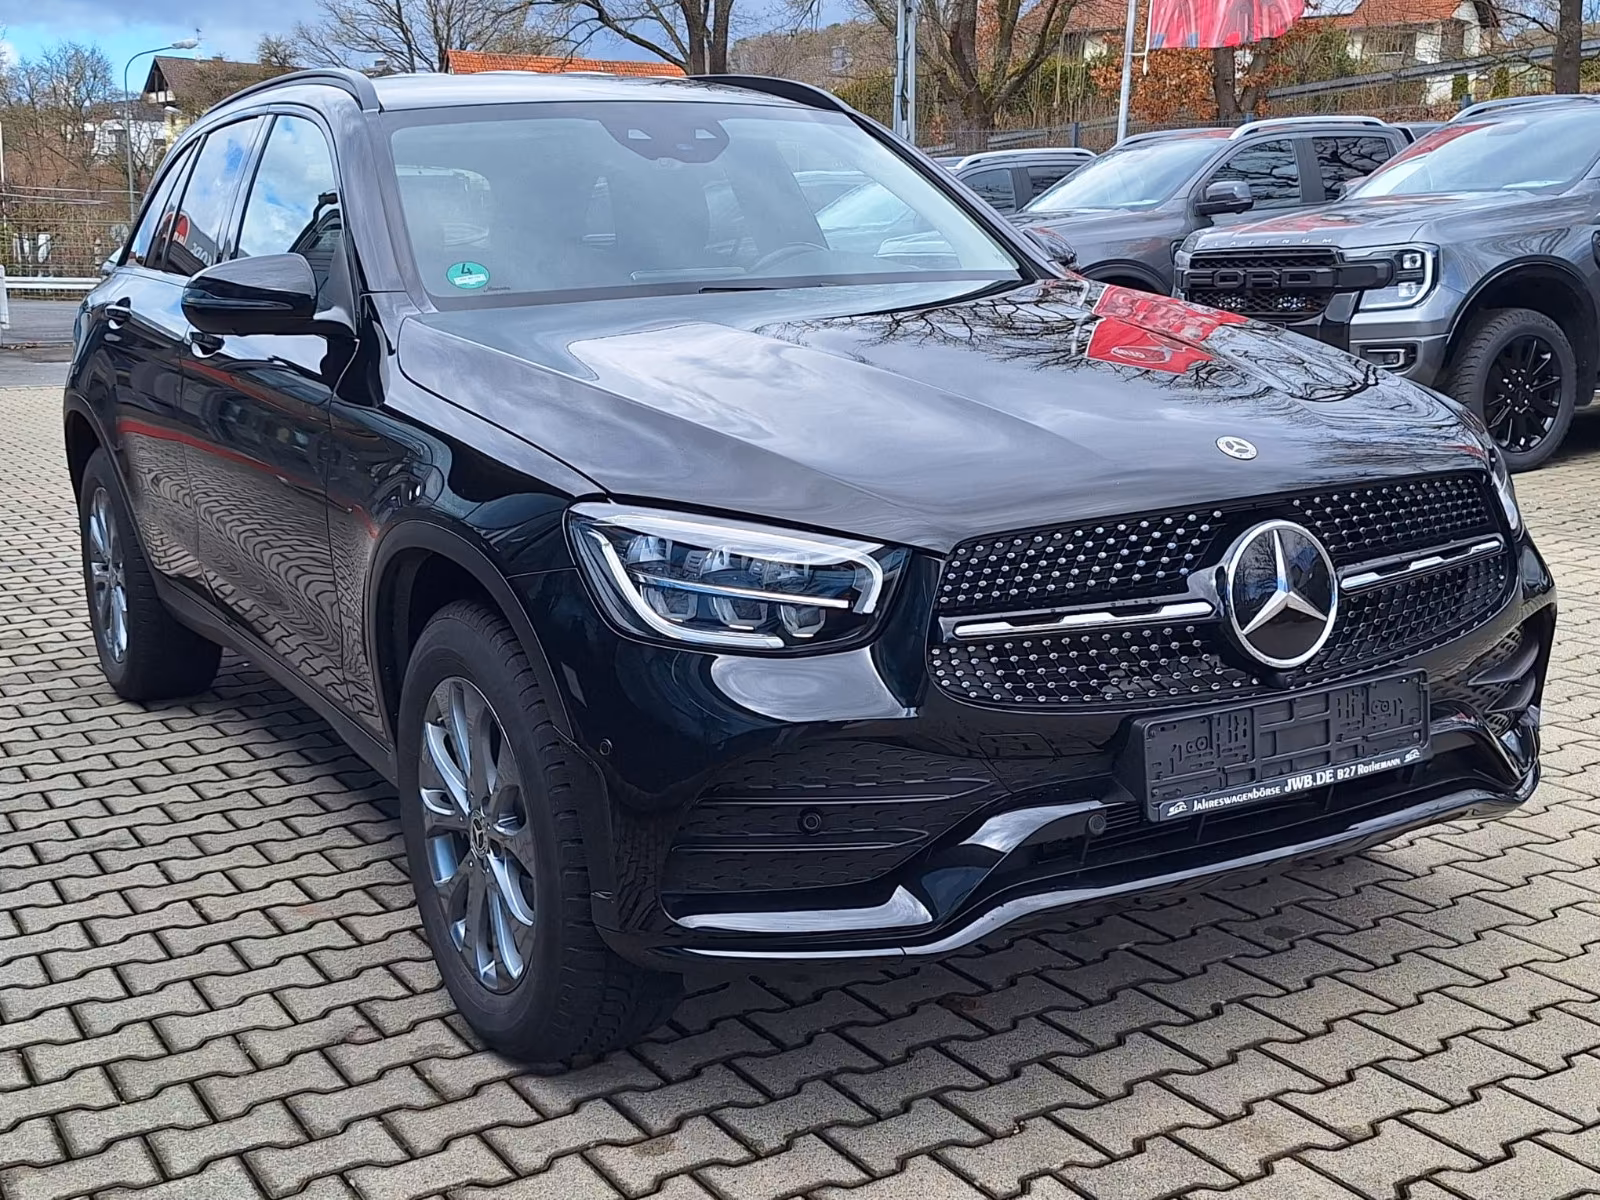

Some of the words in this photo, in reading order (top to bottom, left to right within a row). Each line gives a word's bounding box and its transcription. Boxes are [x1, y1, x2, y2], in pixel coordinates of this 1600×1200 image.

[1199, 237, 1332, 248] PLATINUM
[461, 263, 473, 275] 4
[1183, 268, 1320, 290] FORD
[1284, 769, 1335, 793] JWB.DE
[1337, 764, 1357, 780] B27
